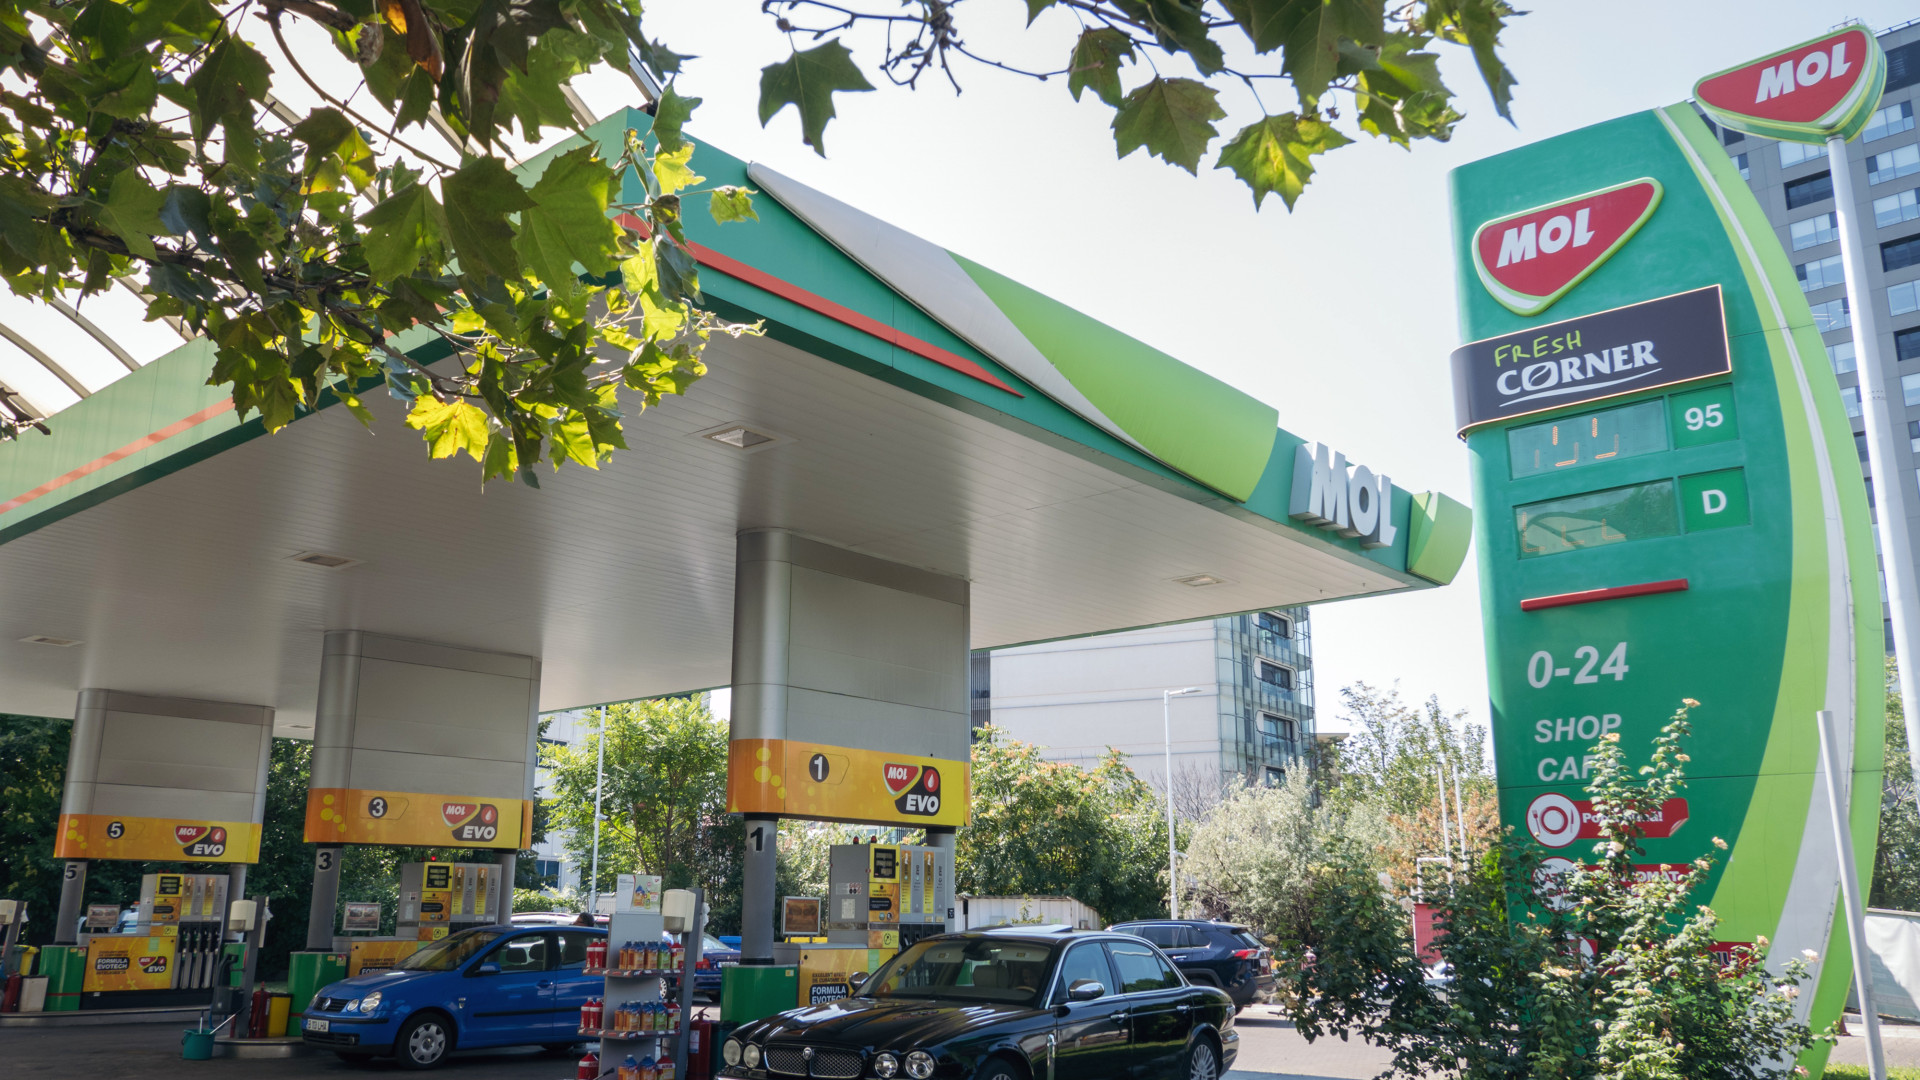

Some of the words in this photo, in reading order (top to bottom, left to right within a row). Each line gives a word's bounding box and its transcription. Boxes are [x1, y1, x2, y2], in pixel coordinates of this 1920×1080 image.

[1755, 41, 1852, 104] MOL
[1496, 207, 1595, 268] MOL
[1494, 330, 1582, 367] FRESH
[1496, 340, 1660, 396] CORNER
[1685, 403, 1723, 431] 95
[1296, 441, 1397, 547] MOL
[1701, 489, 1727, 515] D
[1527, 641, 1629, 689] 0-24
[1534, 713, 1622, 743] SHOP
[813, 755, 823, 780] 1
[887, 766, 908, 780] MOL
[371, 798, 384, 817] 3
[445, 804, 466, 816] MOL
[906, 793, 939, 813] EVO
[110, 822, 121, 838] 5
[178, 827, 197, 836] MOL
[462, 825, 496, 840] EVO
[750, 826, 764, 851] 1
[192, 844, 224, 856] EVO
[318, 851, 332, 870] 3
[65, 864, 77, 880] 5
[147, 965, 166, 973] EVO
[811, 985, 847, 995] FORMULA
